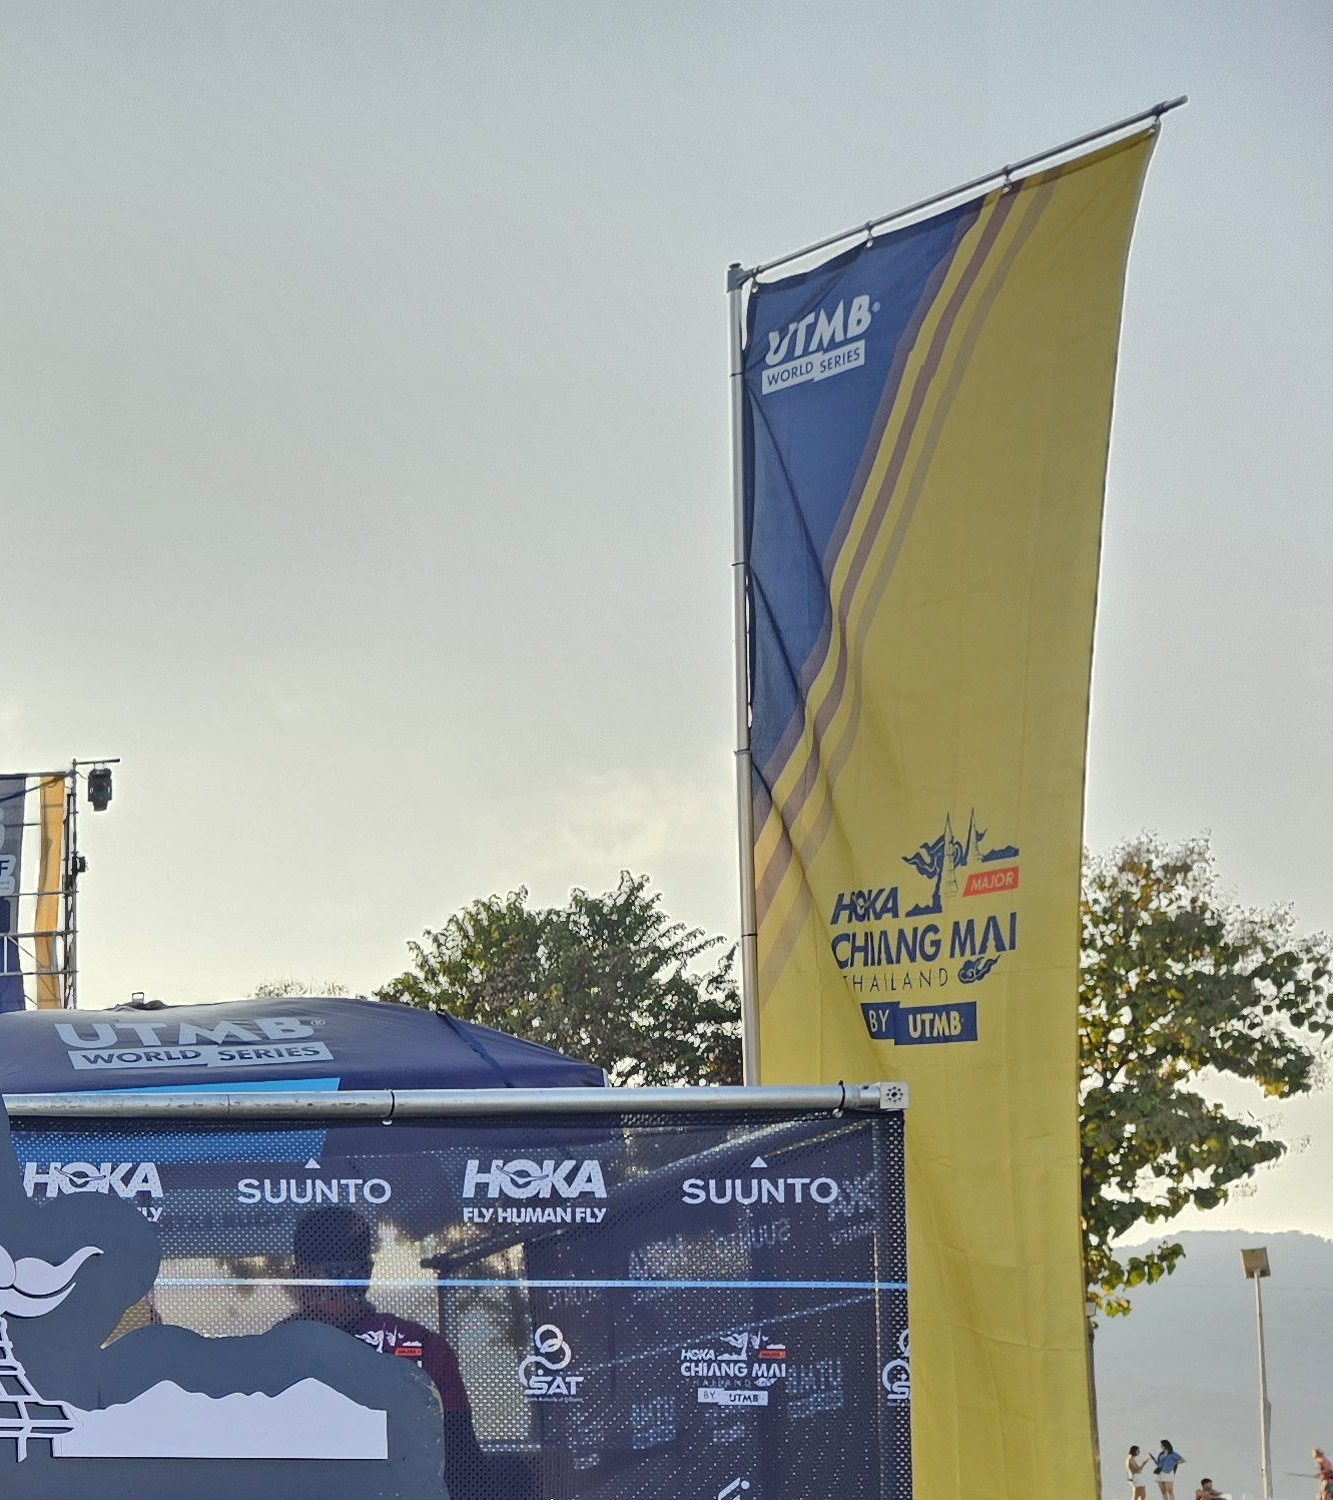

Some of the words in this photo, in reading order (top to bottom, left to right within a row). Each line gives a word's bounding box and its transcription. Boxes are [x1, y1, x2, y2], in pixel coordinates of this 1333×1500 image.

[767, 361, 814, 387] WORLD
[819, 347, 861, 374] SERIES
[970, 872, 1014, 893] MAJOR
[830, 886, 900, 925] HOKA
[831, 924, 942, 970] CHIANG
[949, 912, 1017, 959] MAI
[868, 1008, 890, 1033] BY
[908, 1010, 961, 1039] UTMB
[81, 1049, 201, 1065] WORLD
[219, 1045, 321, 1061] SERIES
[22, 1161, 163, 1198] HOKA
[237, 1177, 392, 1204] SUUNTO
[462, 1159, 607, 1199] HOKA
[681, 1177, 837, 1205] SUUNTO
[463, 1207, 495, 1224] FLY
[497, 1207, 572, 1223] HUMAN
[575, 1207, 607, 1224] FLY
[680, 1349, 716, 1361] HOKA
[680, 1362, 748, 1378] CHIANG
[751, 1363, 786, 1378] MAI
[524, 1376, 584, 1396] SAT
[703, 1390, 717, 1400] BY
[729, 1391, 760, 1404] UTMB
